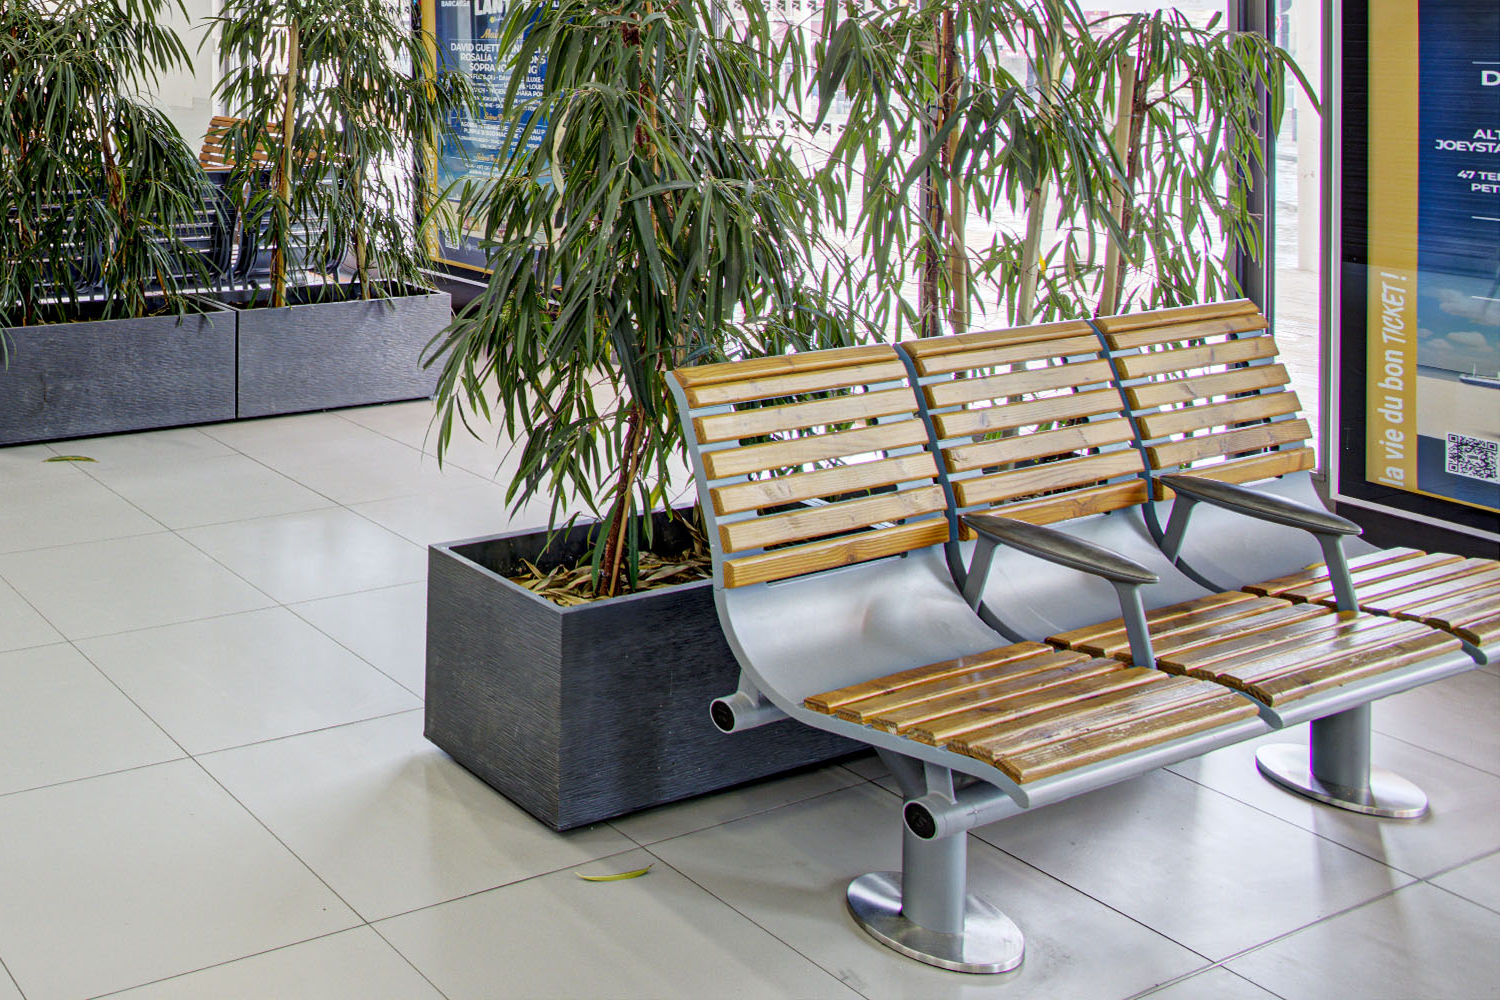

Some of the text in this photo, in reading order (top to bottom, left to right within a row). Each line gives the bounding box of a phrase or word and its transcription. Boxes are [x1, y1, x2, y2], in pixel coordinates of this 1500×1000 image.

[450, 42, 503, 53] DAVID GUETT
[460, 50, 493, 62] ROSALÍA
[1457, 170, 1477, 180] 47
[1380, 282, 1406, 344] TICKET
[1378, 349, 1404, 391] bon
[1377, 396, 1404, 424] du
[1380, 428, 1404, 463] vie
[1379, 466, 1404, 487] la
